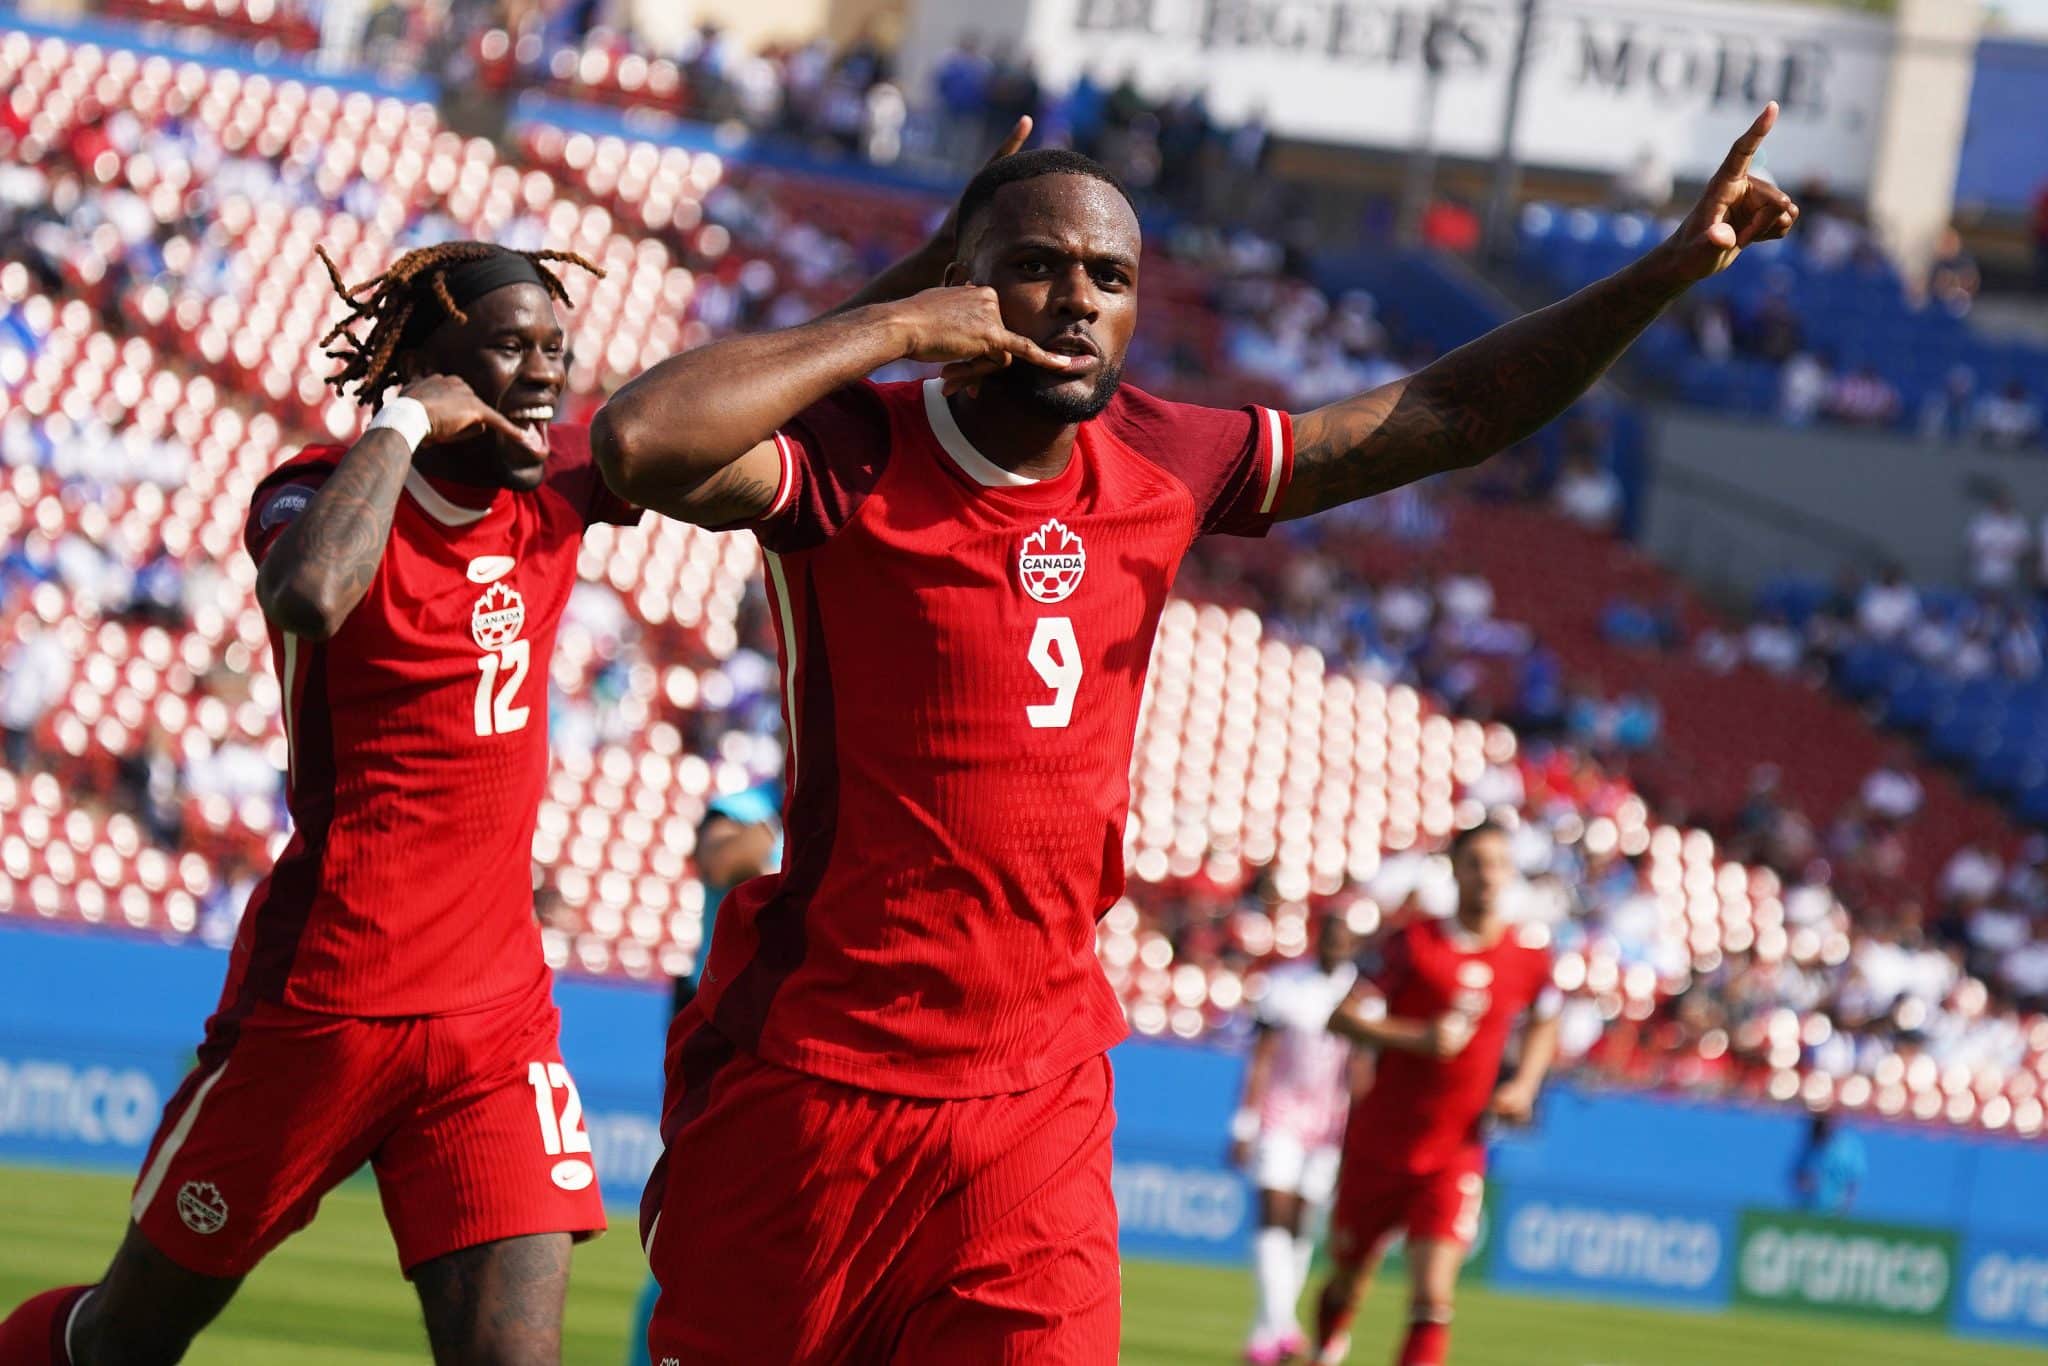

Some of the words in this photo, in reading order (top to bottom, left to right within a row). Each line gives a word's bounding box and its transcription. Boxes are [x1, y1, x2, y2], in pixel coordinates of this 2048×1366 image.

[1568, 17, 1831, 120] MORE
[1022, 557, 1082, 570] CANADA
[474, 638, 530, 737] 12
[1026, 617, 1083, 728] 9
[0, 1062, 157, 1144] mco
[528, 1061, 592, 1156] 12
[1508, 1201, 1721, 1290] aramco
[1740, 1226, 1950, 1313] aramco
